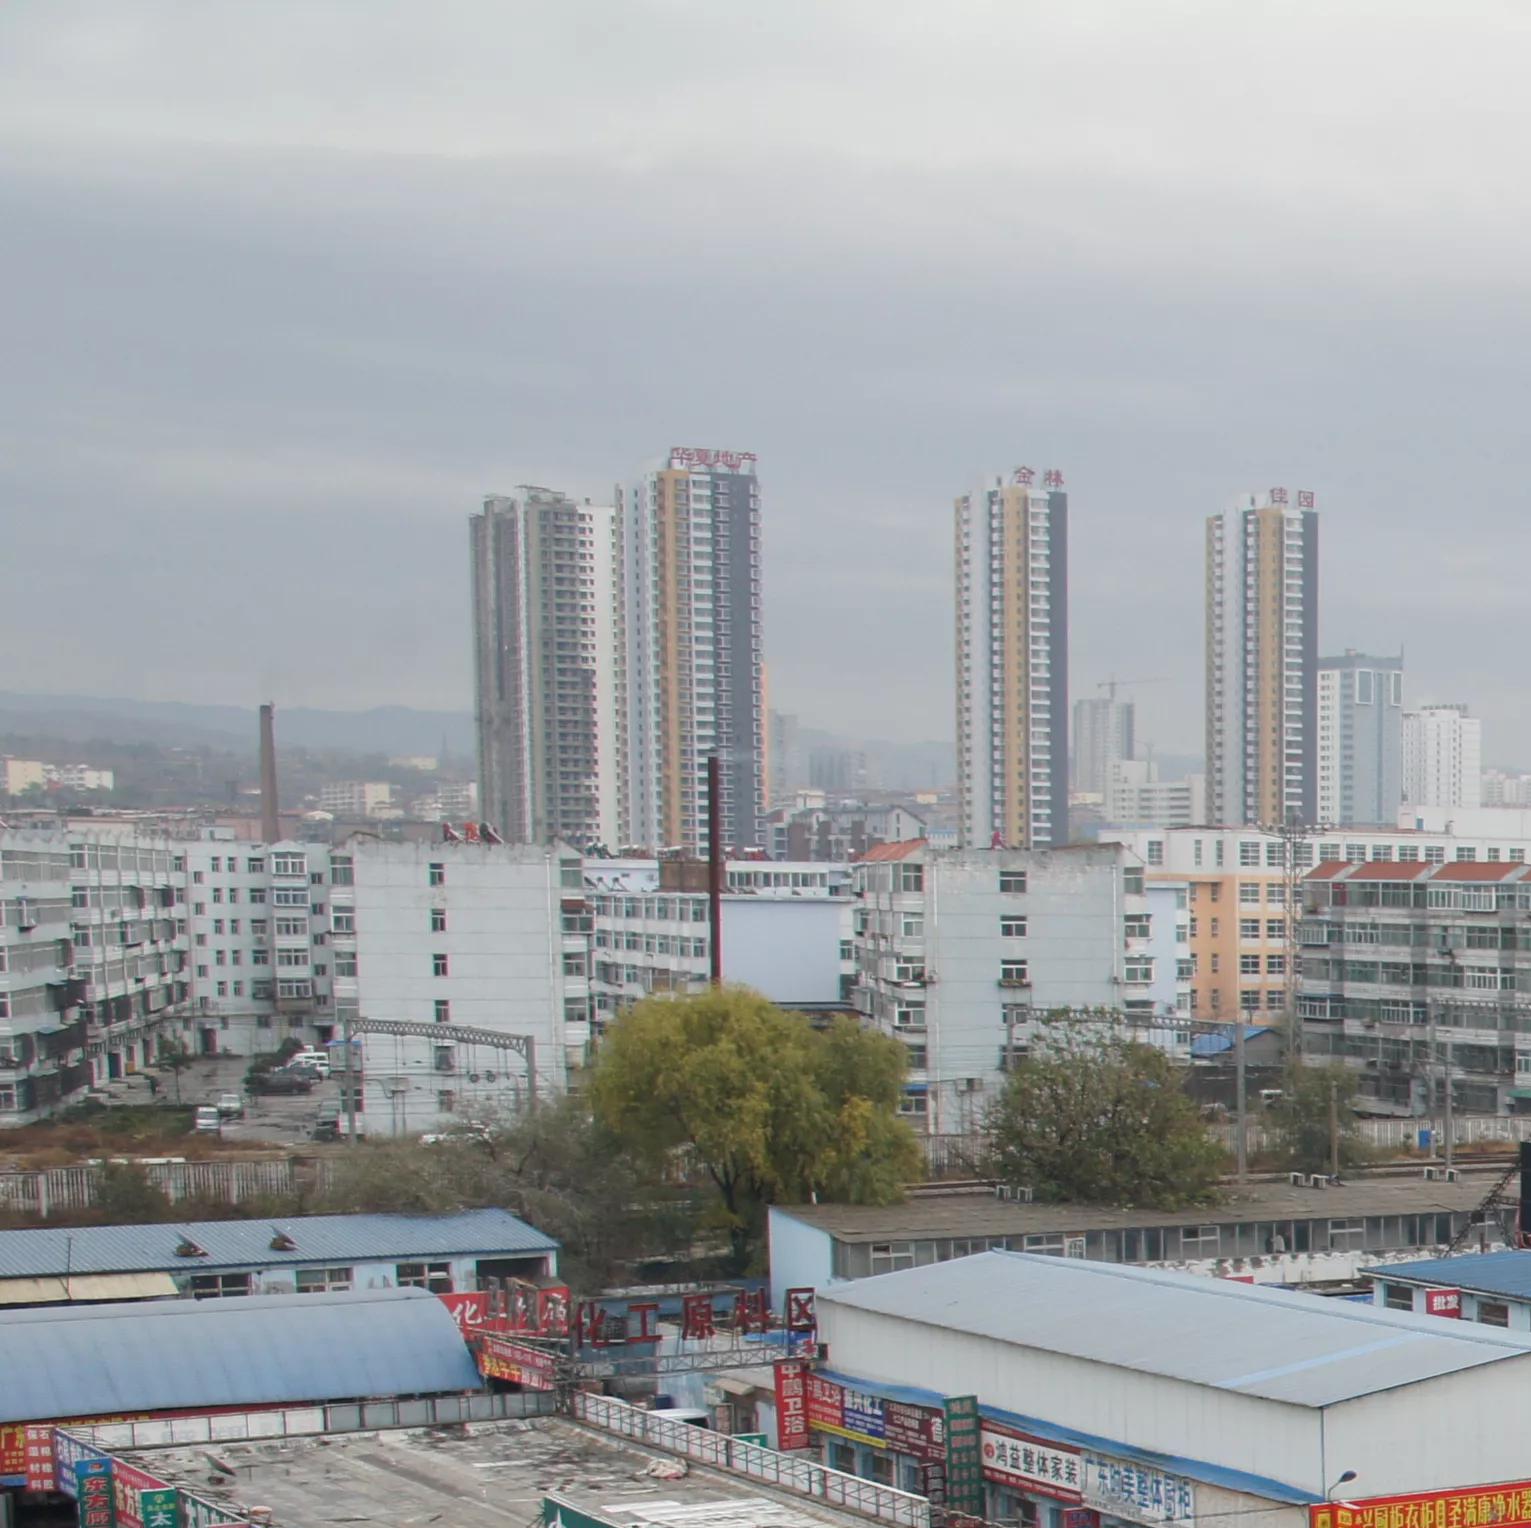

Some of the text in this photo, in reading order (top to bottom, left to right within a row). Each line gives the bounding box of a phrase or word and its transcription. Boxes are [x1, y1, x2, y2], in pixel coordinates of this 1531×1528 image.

[669, 447, 758, 471] 华夏地产
[1014, 465, 1065, 487] 金林
[1269, 486, 1315, 508] 佳园
